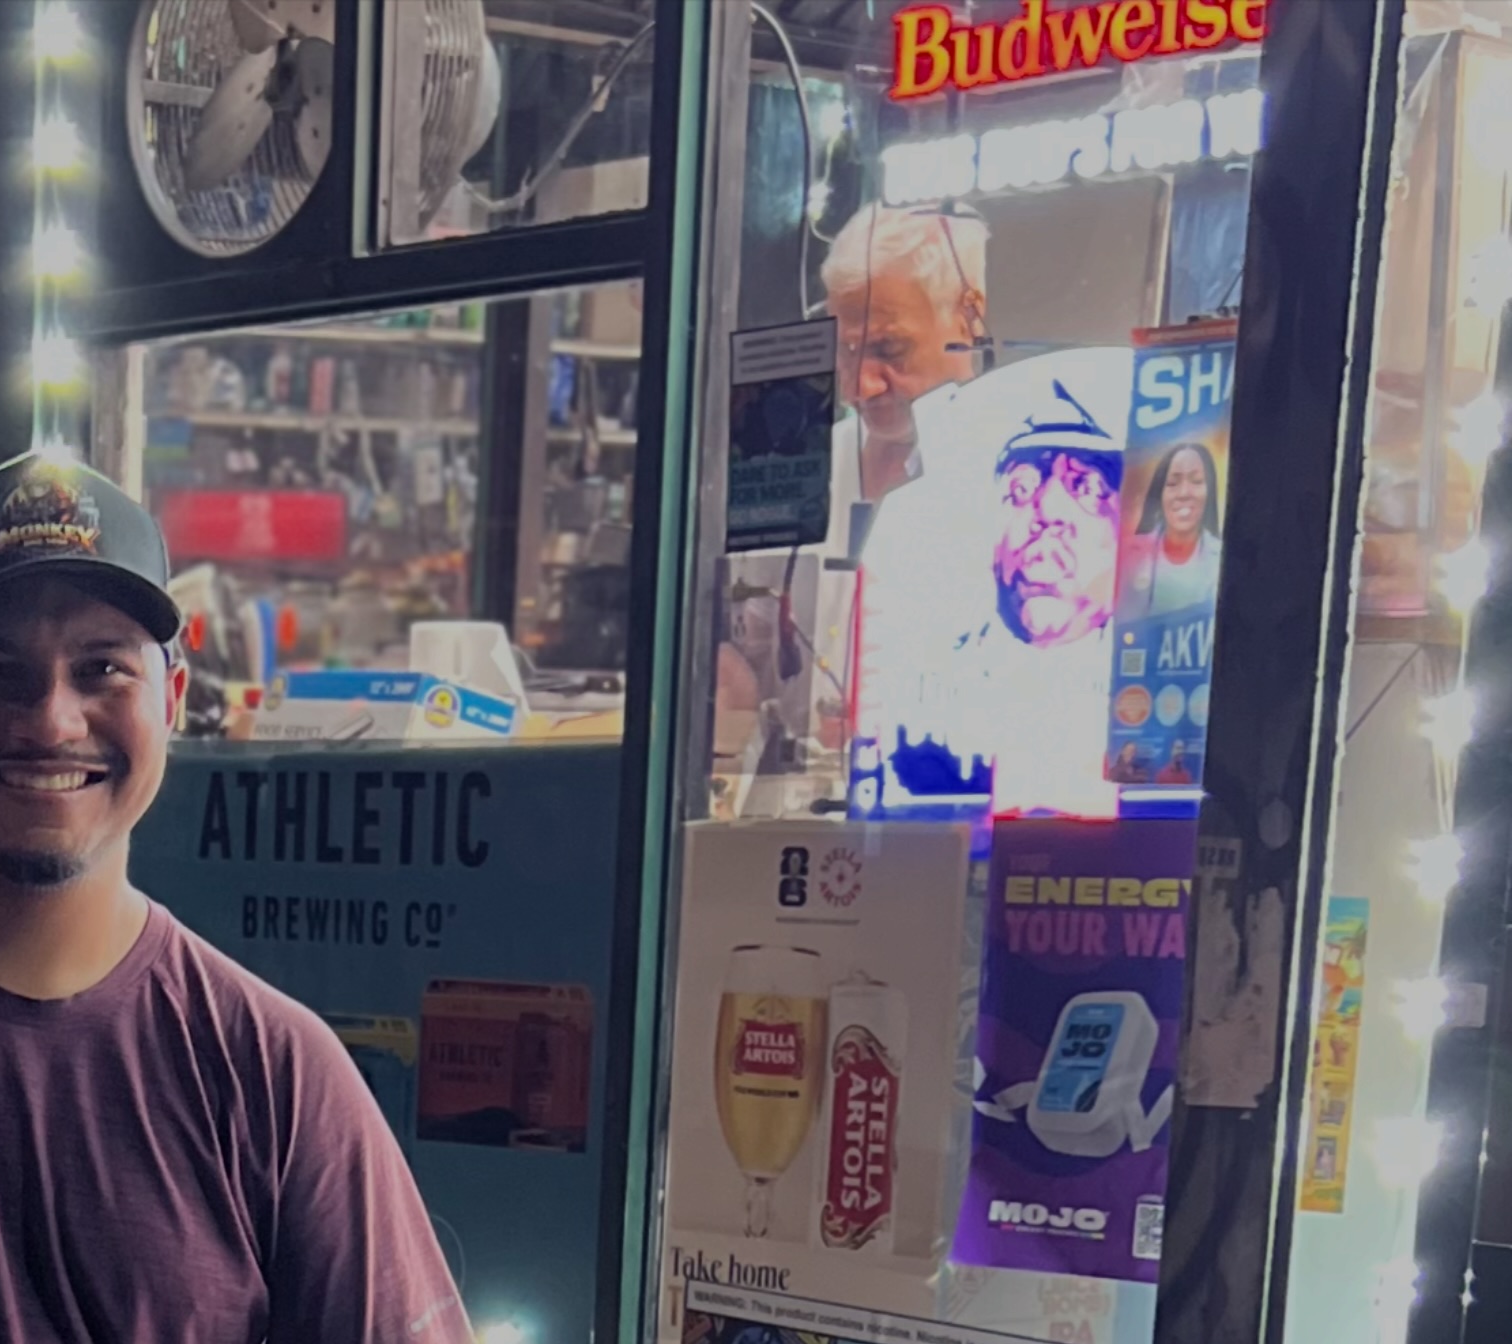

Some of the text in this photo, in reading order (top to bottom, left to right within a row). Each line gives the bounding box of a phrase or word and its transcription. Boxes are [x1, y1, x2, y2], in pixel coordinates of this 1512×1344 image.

[198, 771, 492, 868] ATHLETIC
[242, 895, 389, 946] BREWING
[1004, 910, 1107, 956] YOUR
[743, 1048, 796, 1065] ARTOIS
[744, 1030, 796, 1048] STELLA
[841, 1072, 868, 1210] ARTOIS
[864, 1076, 889, 1211] STELLA
[989, 1199, 1107, 1231] MOJO
[670, 1246, 791, 1291] Take home
[751, 1299, 773, 1315] This
[775, 1306, 816, 1323] product
[818, 1314, 865, 1331] contains
